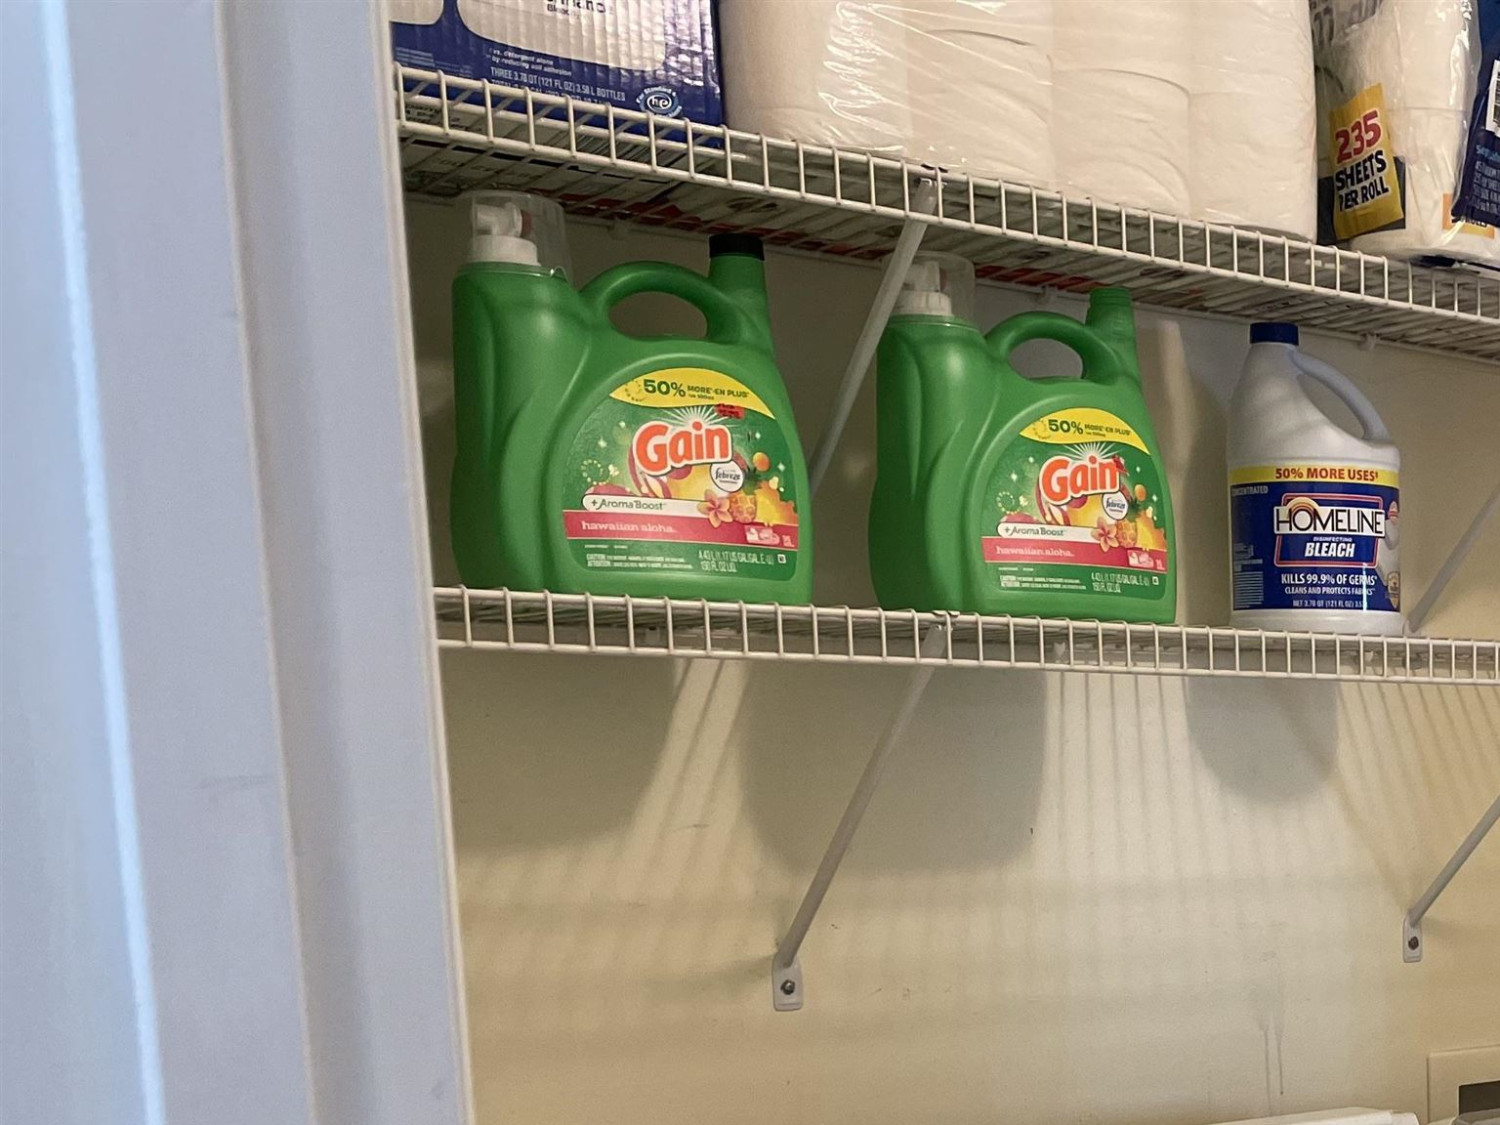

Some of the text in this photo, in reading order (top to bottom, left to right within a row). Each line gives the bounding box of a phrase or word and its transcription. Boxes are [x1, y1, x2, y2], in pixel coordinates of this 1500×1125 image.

[490, 66, 514, 80] THREE
[596, 87, 626, 101] BOTTLES
[1335, 110, 1383, 165] 235
[1335, 150, 1387, 192] SHEETS
[1360, 180, 1390, 205] ROLL
[643, 379, 686, 398] 50%
[1048, 419, 1084, 435] 50%
[634, 420, 731, 474] Gain
[1042, 455, 1119, 502] Gain
[1275, 467, 1304, 480] 50%
[1306, 467, 1345, 480] MORE
[582, 520, 639, 532] hawaiian
[1276, 508, 1384, 534] HOMELINE
[1304, 542, 1356, 557] BLEACH
[1281, 573, 1306, 585] KILLS
[1306, 574, 1336, 585] 99.9%
[1336, 574, 1348, 585] OF
[1284, 586, 1308, 595] CLEANS
[1308, 586, 1321, 595] AND
[1321, 586, 1351, 595] PROTECTS
